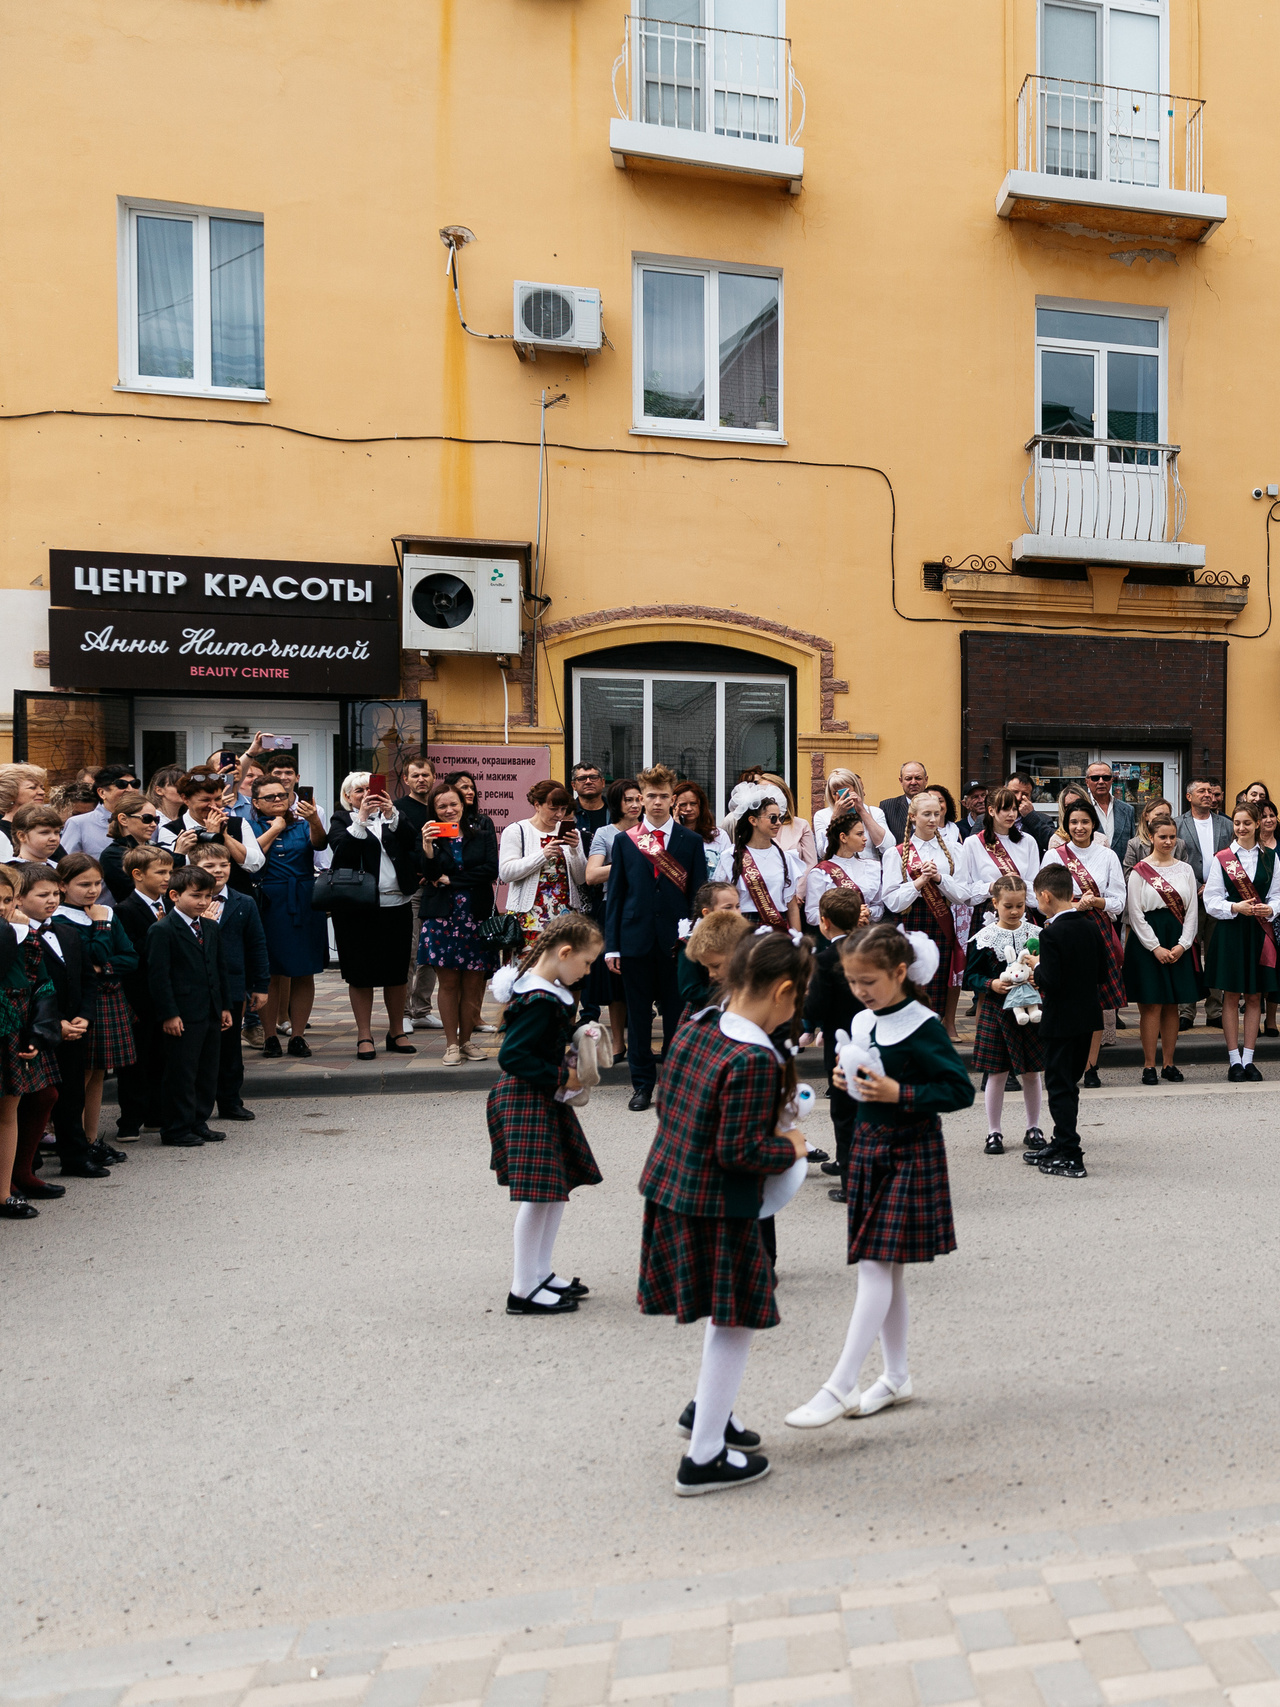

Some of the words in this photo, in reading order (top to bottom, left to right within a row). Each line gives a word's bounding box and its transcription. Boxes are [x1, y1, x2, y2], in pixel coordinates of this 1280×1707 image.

[74, 566, 187, 595] ЦЕНТР
[204, 573, 373, 603] КРАСОТЫ
[79, 625, 169, 654] Анны
[179, 628, 371, 660] Ниточкиной
[190, 666, 238, 677] BEAUTY
[241, 667, 289, 679] CENTRE
[443, 756, 480, 766] стрижки,
[482, 757, 536, 767] окрашивание
[486, 773, 518, 781] макияж
[485, 791, 514, 800] ресниц
[478, 808, 509, 818] едикюр
